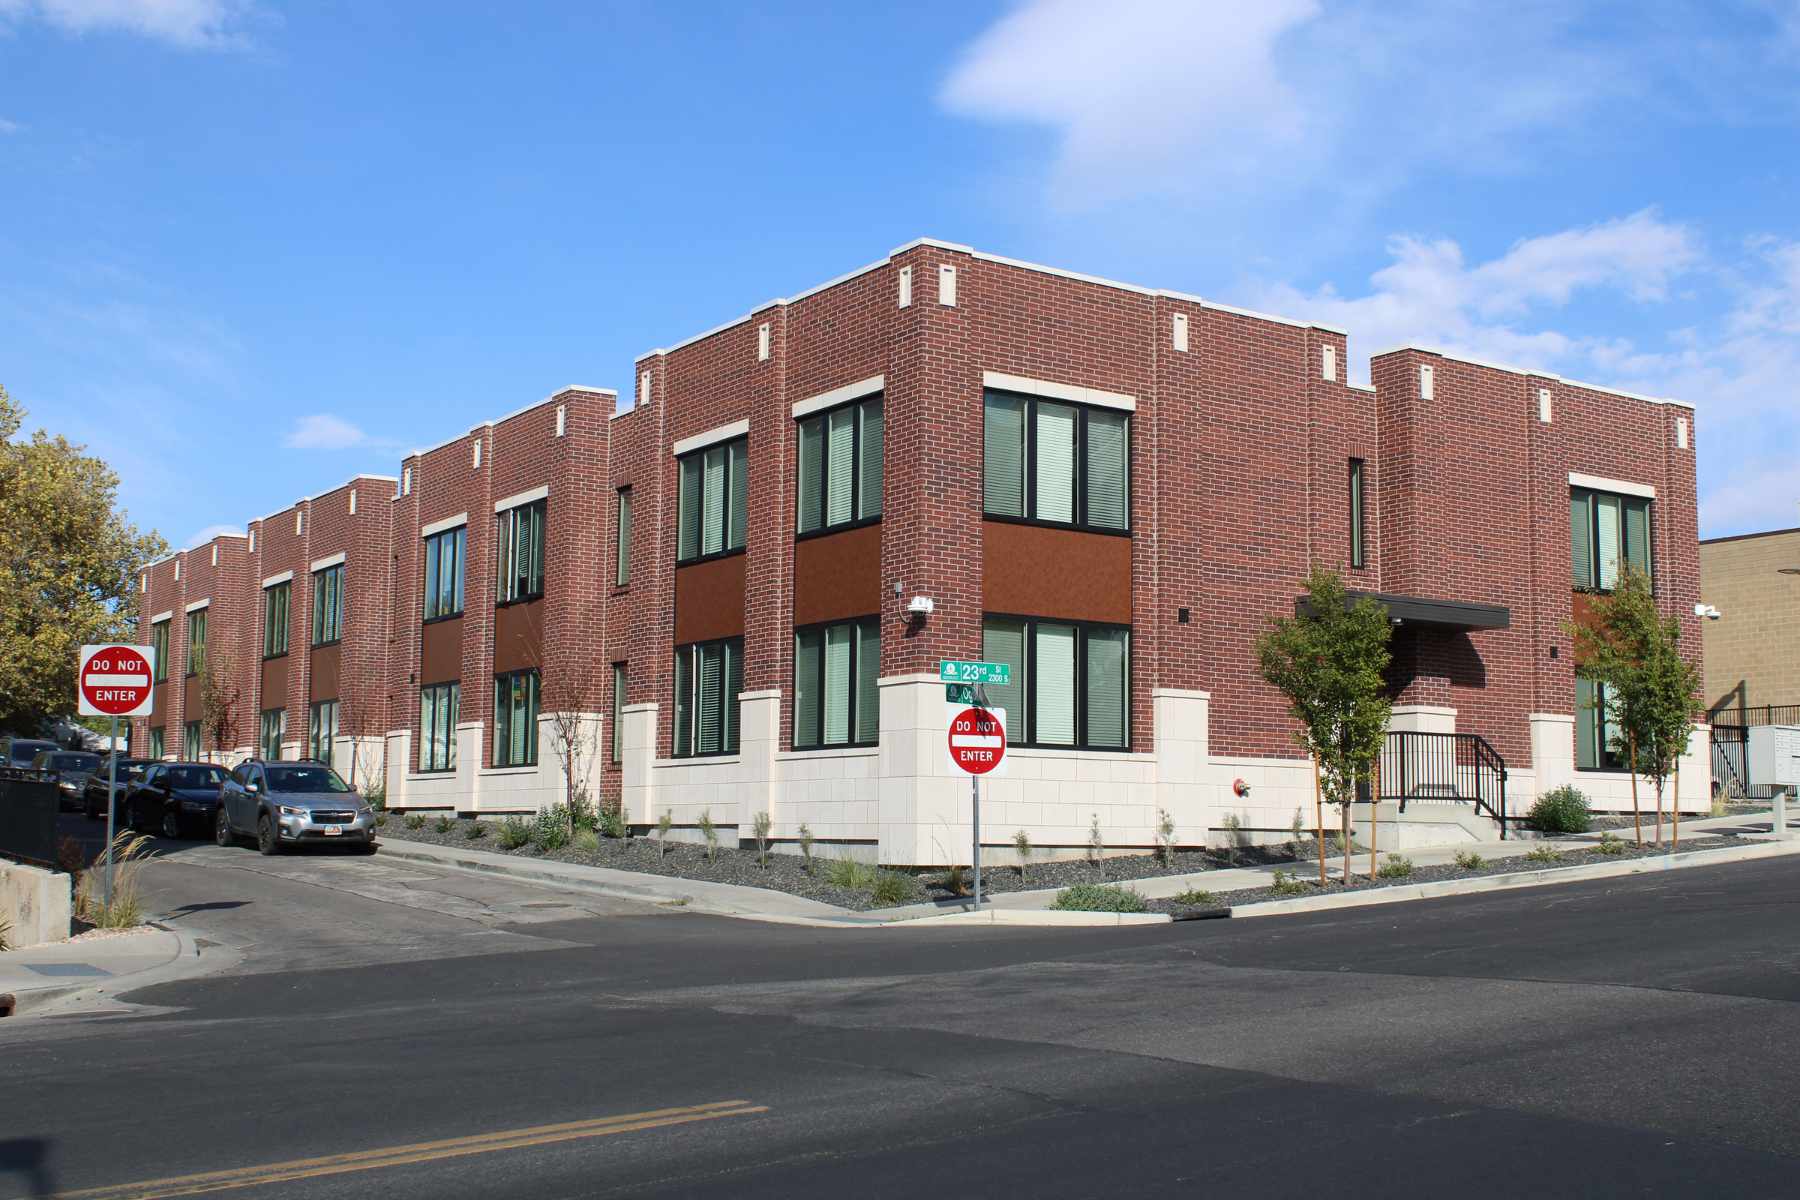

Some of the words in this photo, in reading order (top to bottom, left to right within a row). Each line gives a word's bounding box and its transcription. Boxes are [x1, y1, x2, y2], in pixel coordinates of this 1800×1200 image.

[92, 660, 110, 671] DO
[118, 660, 143, 671] NOT
[962, 664, 987, 680] 23rd
[96, 690, 137, 701] ENTER
[956, 721, 971, 731] DO
[976, 721, 997, 732] NOT
[960, 751, 993, 762] ENTER
